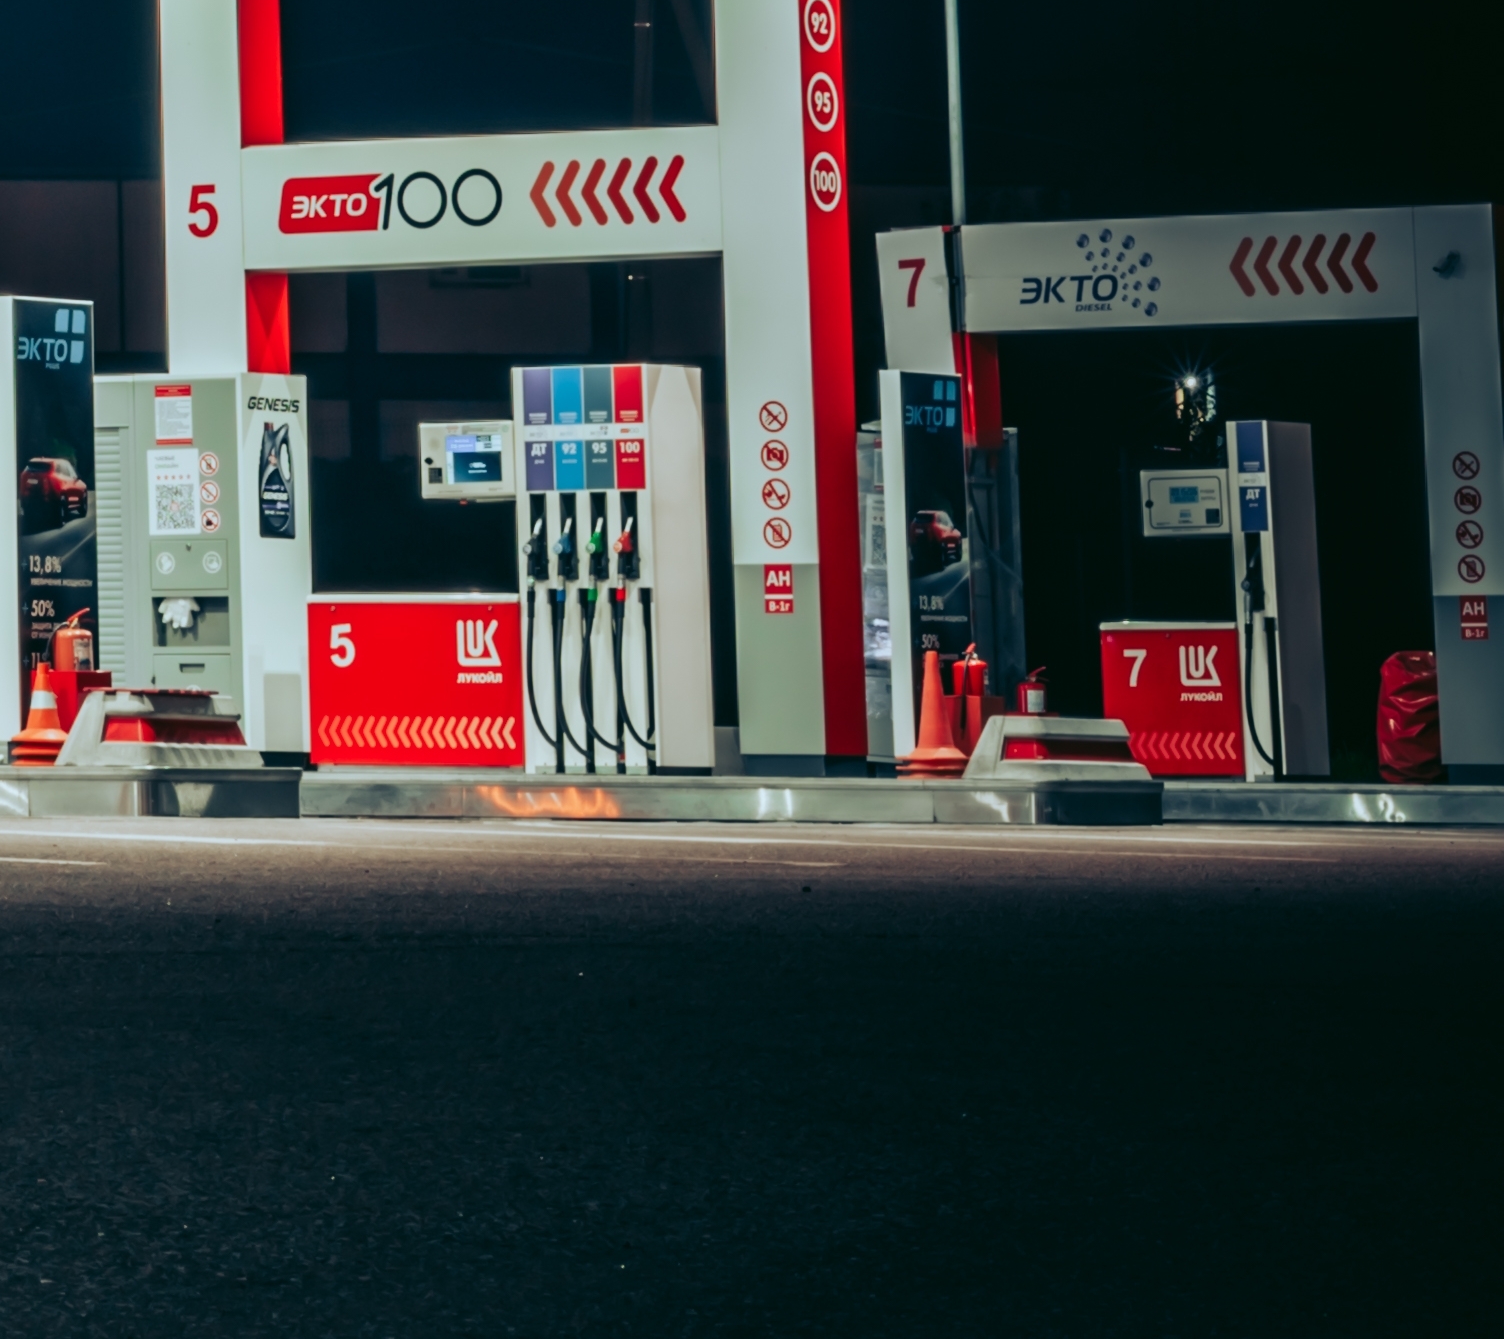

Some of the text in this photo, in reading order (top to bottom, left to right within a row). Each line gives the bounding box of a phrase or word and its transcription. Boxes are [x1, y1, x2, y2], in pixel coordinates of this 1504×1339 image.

[811, 12, 829, 34] 92
[814, 91, 832, 113] 95
[814, 170, 837, 193] 100
[188, 184, 219, 238] 5
[898, 257, 926, 308] 7
[1019, 273, 1119, 305] ЭКТО
[1075, 302, 1113, 313] DIESEL
[17, 337, 68, 362] ЭКТО
[247, 396, 300, 414] GENESIS
[905, 406, 943, 426] ЭКТО
[531, 443, 547, 457] ДТ
[562, 443, 577, 455] 92
[592, 443, 607, 454] 95
[619, 441, 640, 453] 100
[1246, 488, 1260, 501] ДТ
[329, 623, 356, 668] 5
[456, 671, 503, 684] ЛУКОЙЛ
[1123, 648, 1148, 687] 7
[1180, 691, 1223, 703] ЛУКОЙЛ
